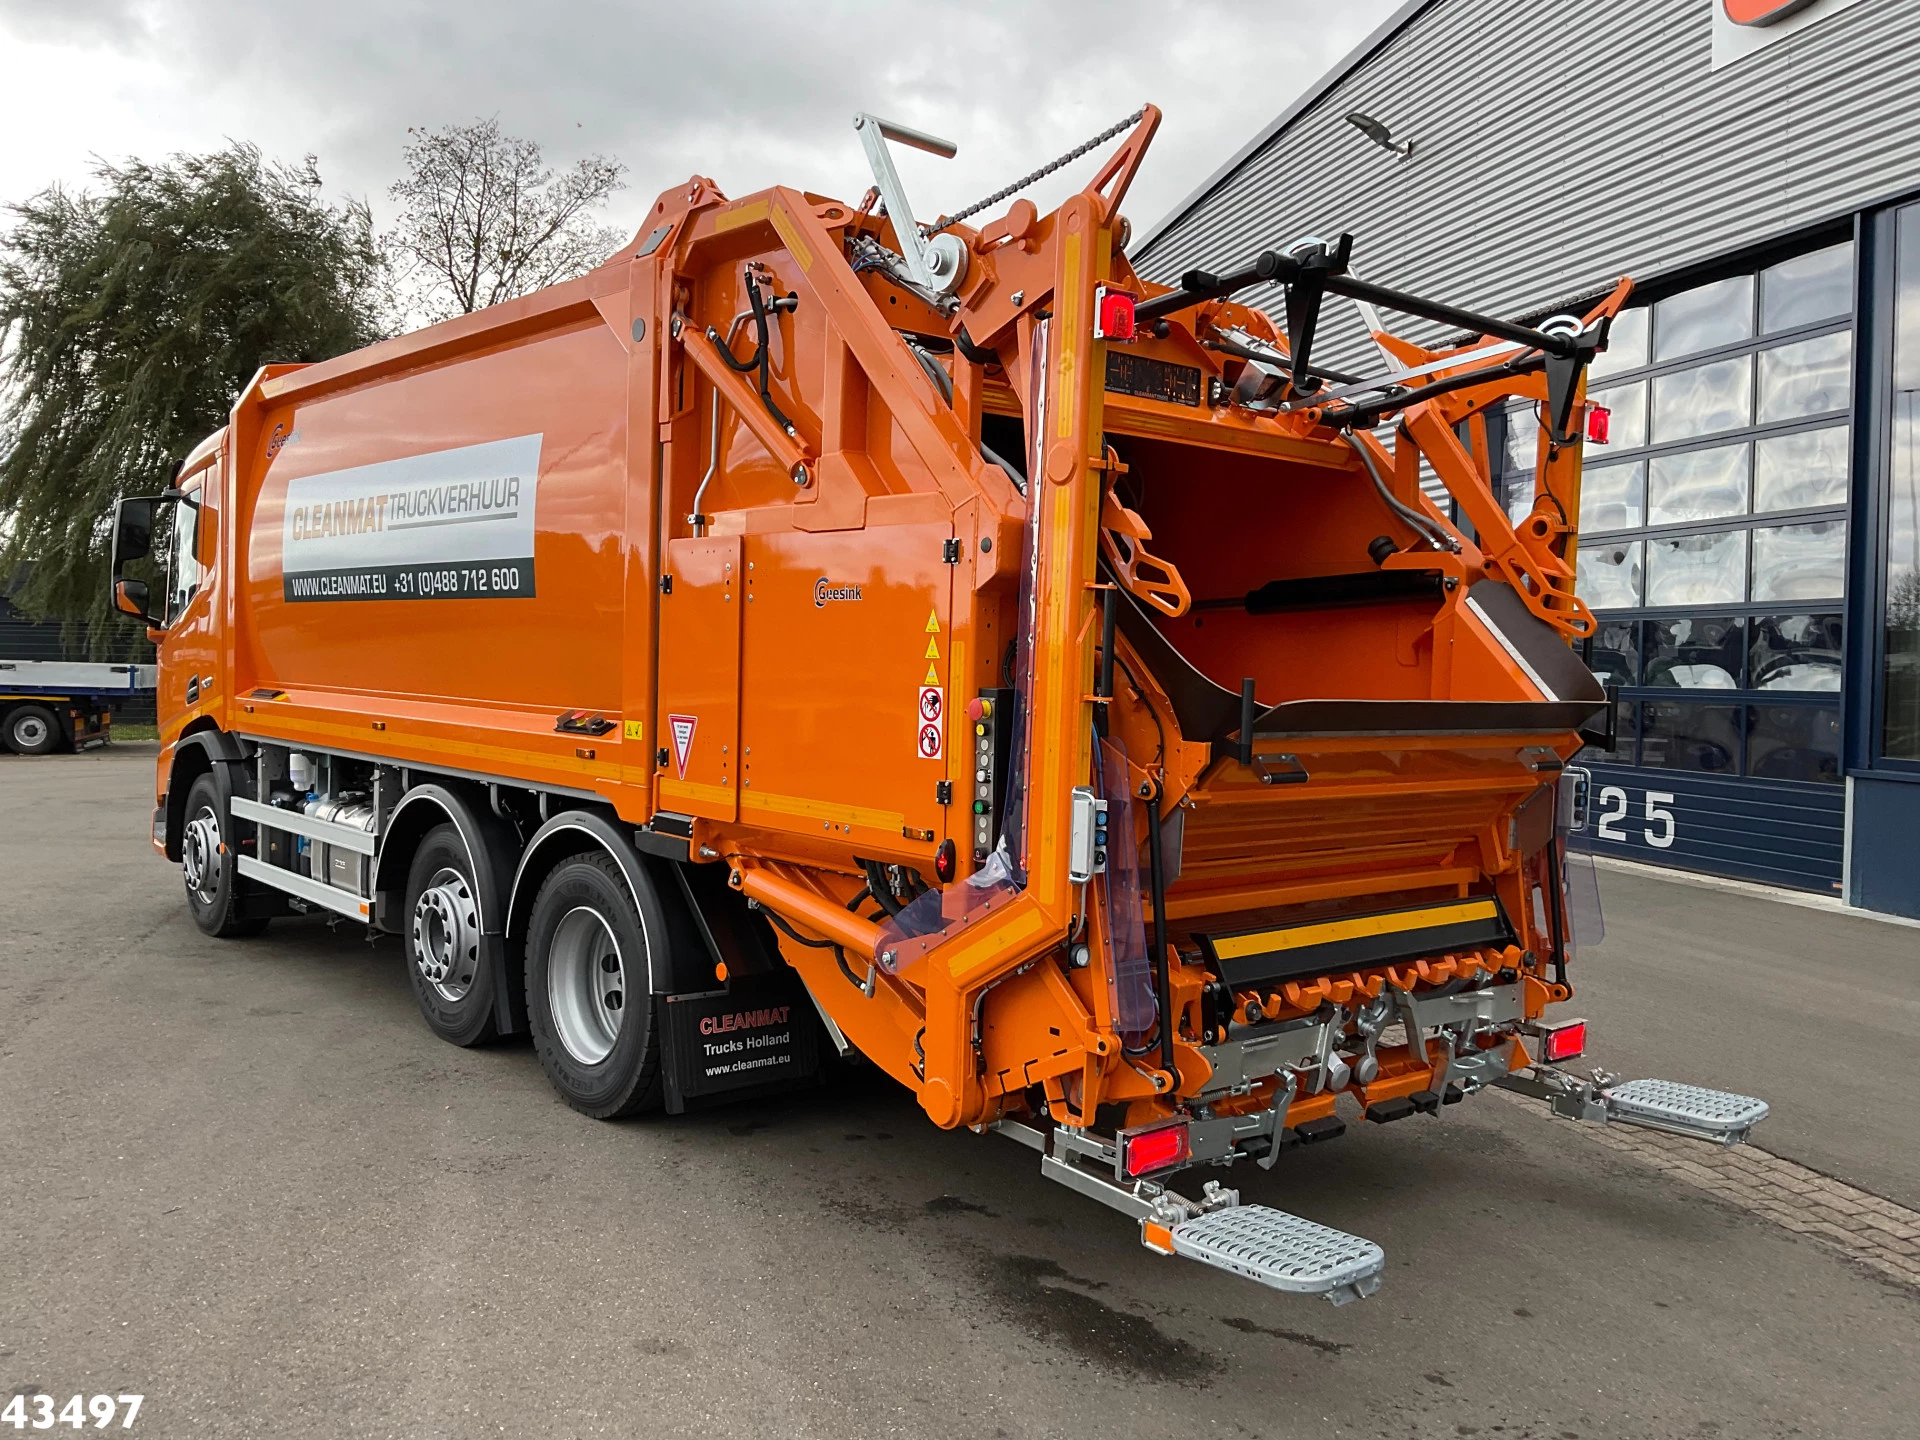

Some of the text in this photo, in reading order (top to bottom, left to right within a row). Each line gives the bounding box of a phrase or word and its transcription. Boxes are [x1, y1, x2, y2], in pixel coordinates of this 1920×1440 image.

[292, 567, 520, 596] WWW.CLEANMAT.EU +31 (0)488 712 600
[815, 580, 862, 603] Geesink
[700, 1006, 790, 1035] CLEANMAT
[703, 1032, 790, 1056] Trucks Holland
[705, 1055, 791, 1077] www.cleanmat.eu
